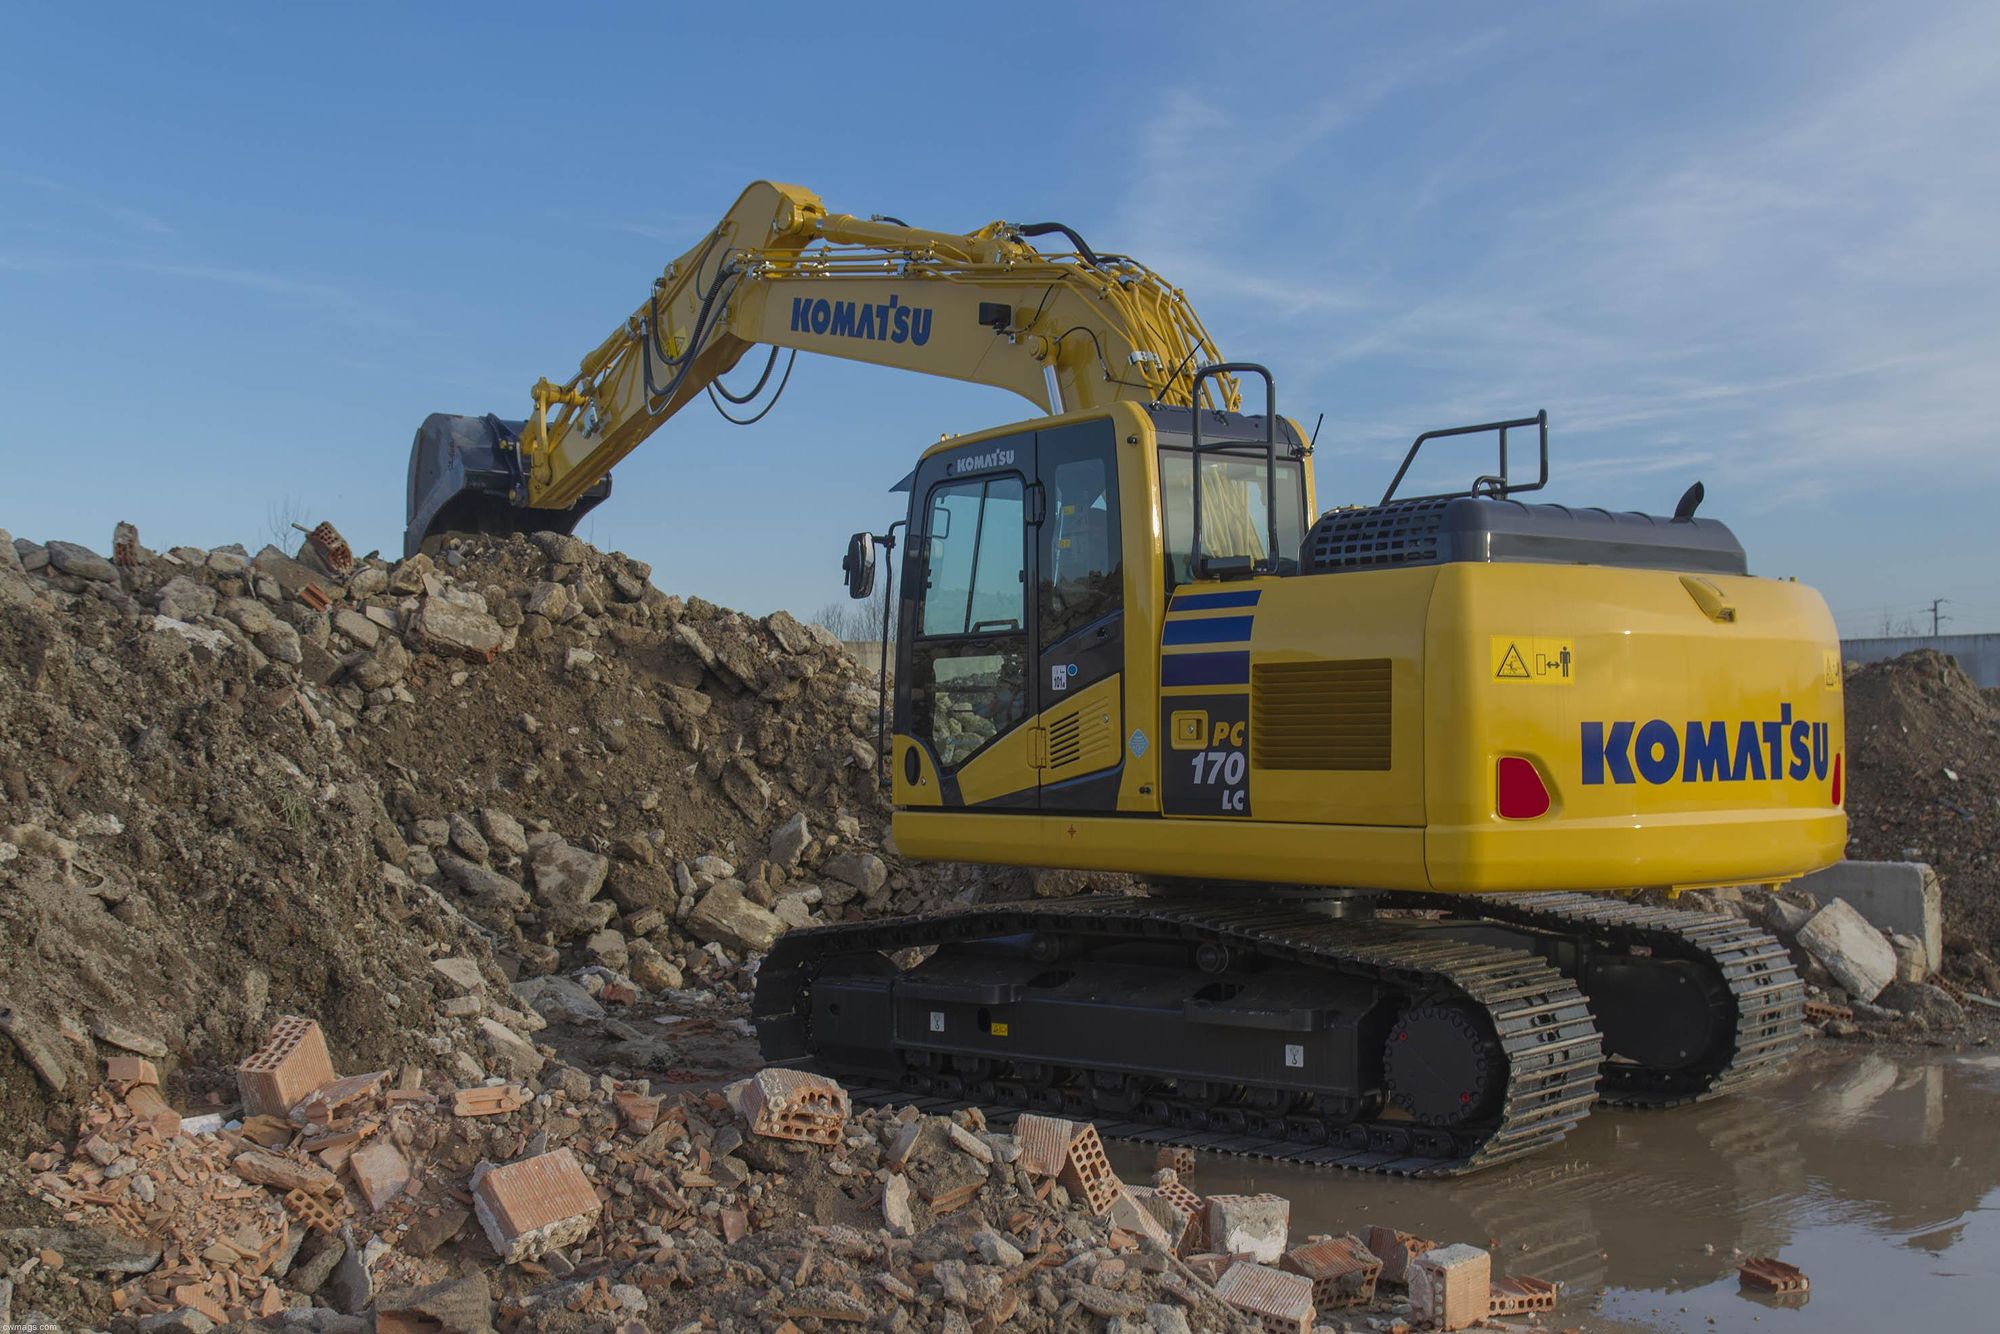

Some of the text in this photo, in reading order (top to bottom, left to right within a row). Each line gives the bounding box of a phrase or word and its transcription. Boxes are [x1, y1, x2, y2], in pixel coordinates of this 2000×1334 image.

[791, 294, 932, 346] KOMATSU
[957, 448, 1015, 472] KOMATSU
[1212, 720, 1246, 747] PC
[1580, 702, 1828, 784] KOMATSU
[1191, 751, 1246, 786] 170
[1222, 789, 1246, 811] LC
